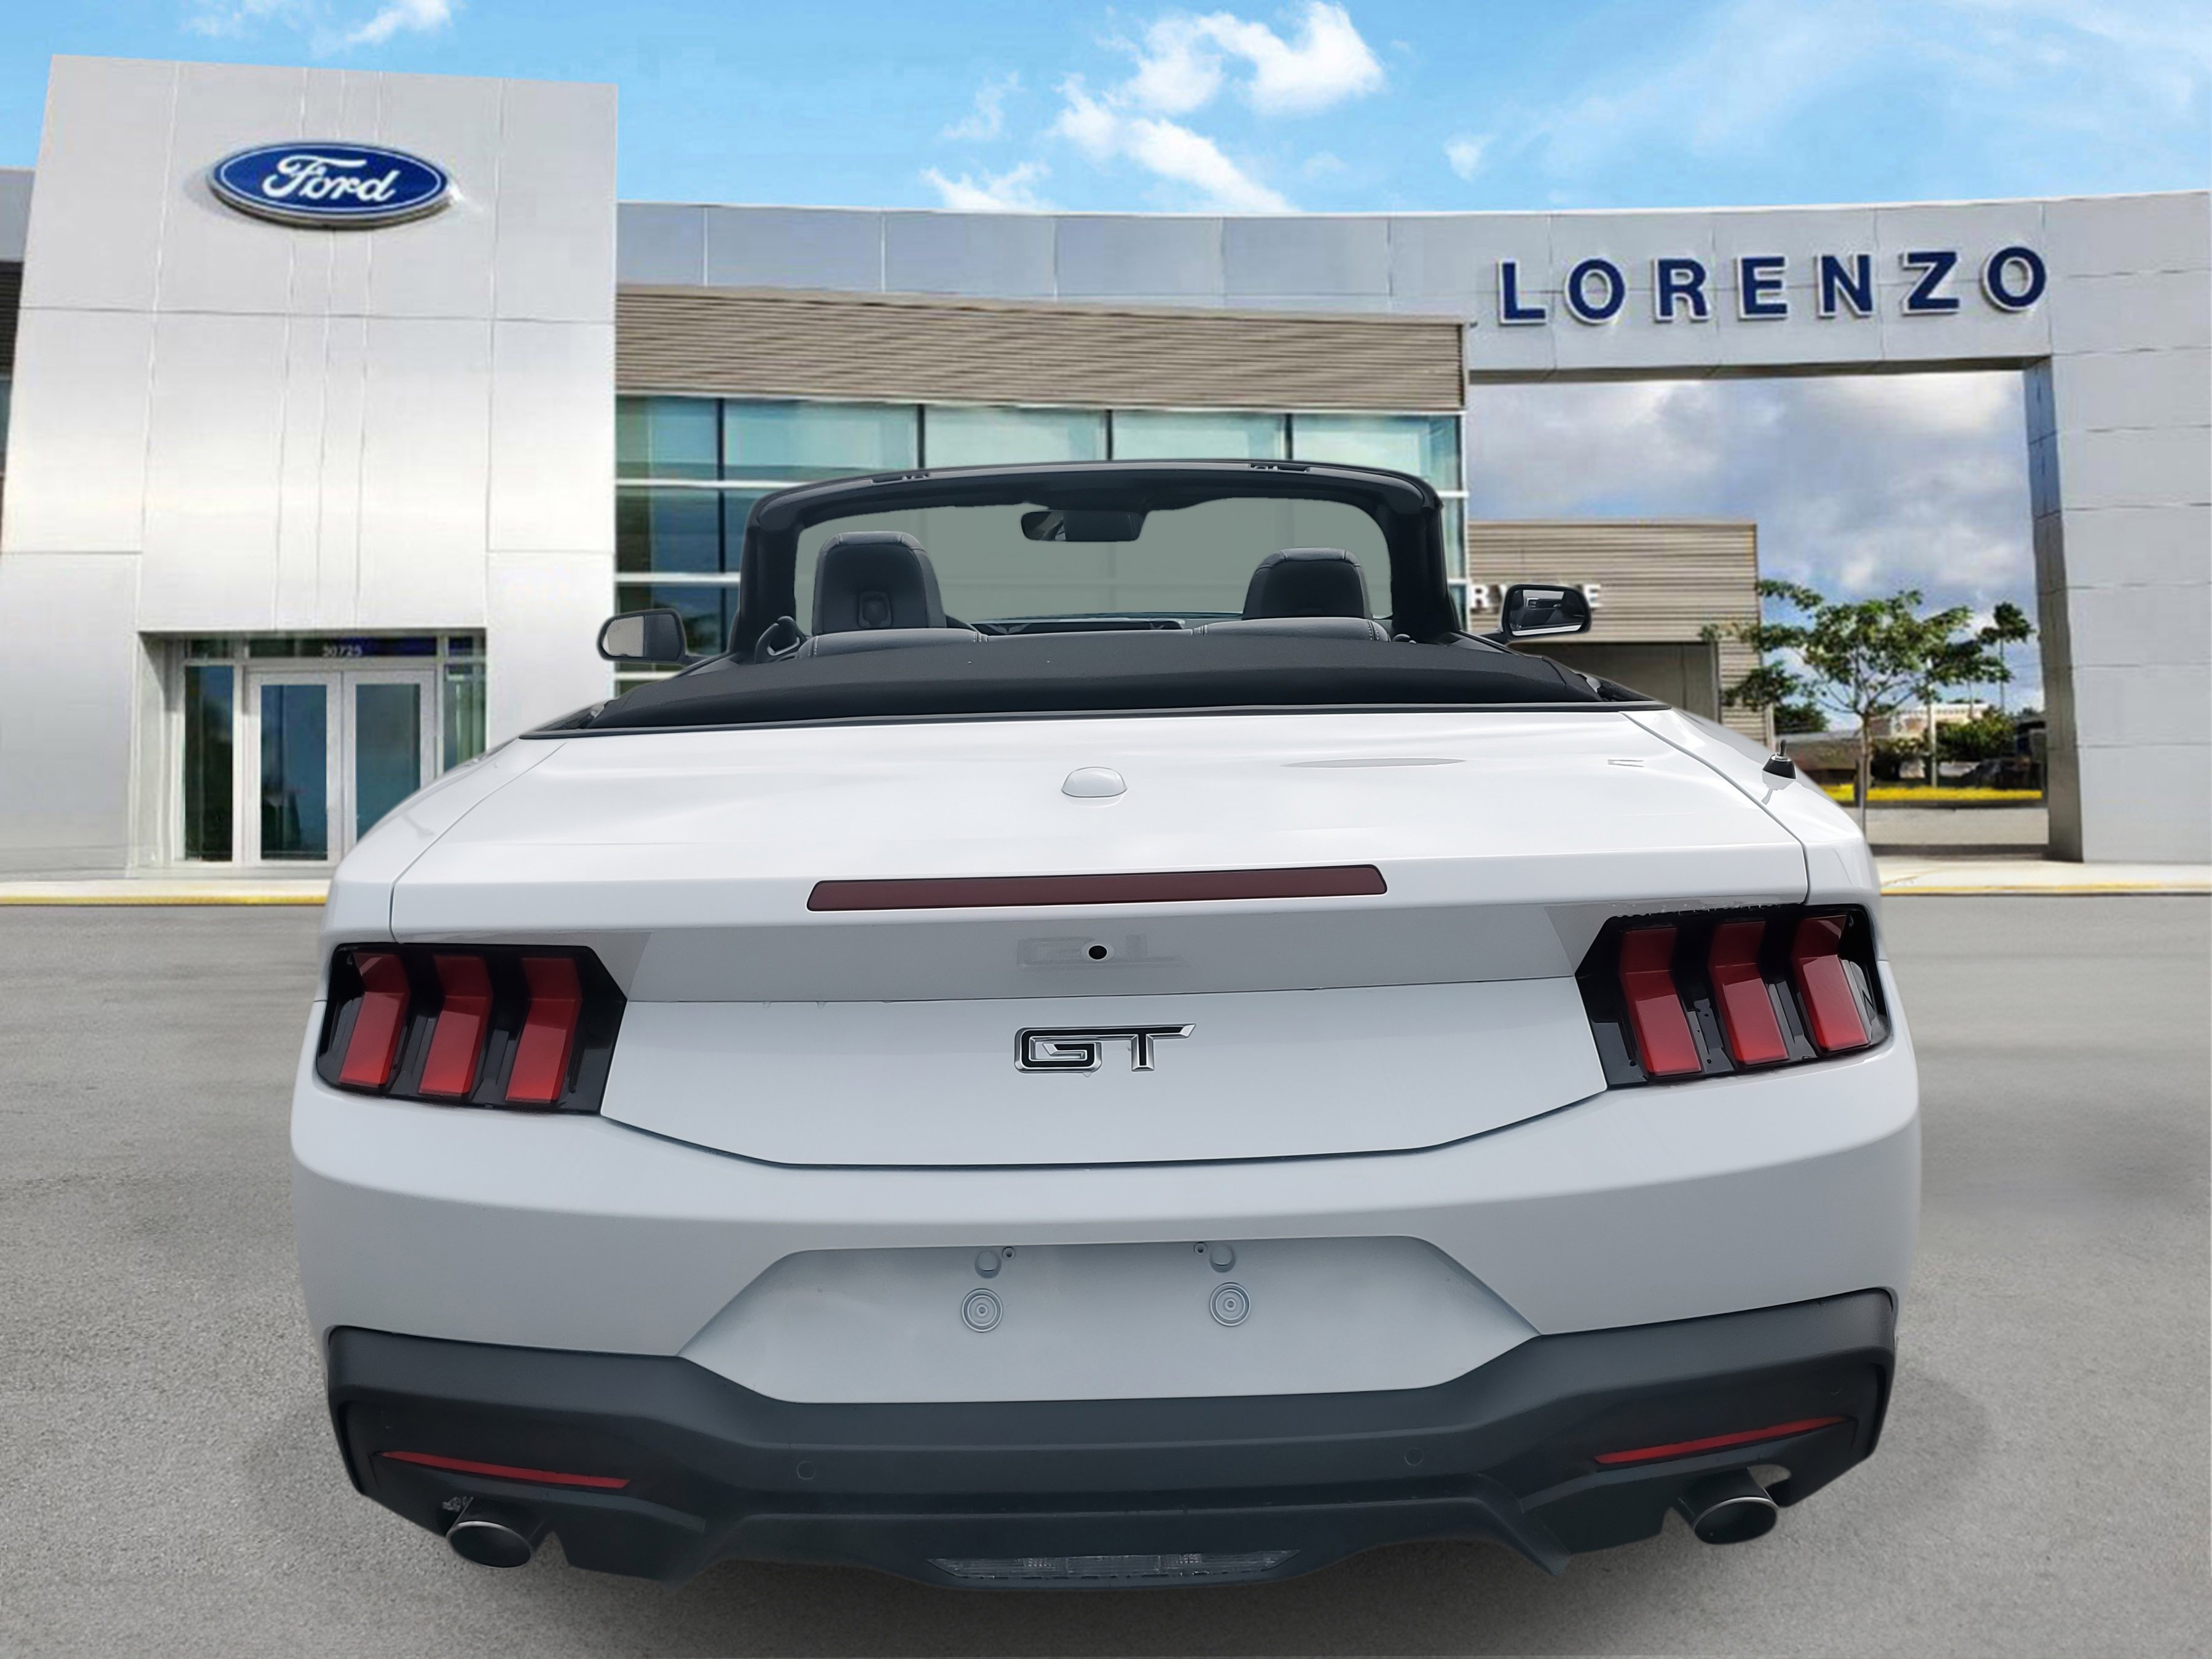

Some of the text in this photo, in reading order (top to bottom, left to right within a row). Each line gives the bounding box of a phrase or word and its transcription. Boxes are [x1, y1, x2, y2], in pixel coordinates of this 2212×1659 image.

[262, 154, 400, 202] Ford
[1498, 246, 2047, 324] LORENZO
[1014, 1023, 1196, 1074] GT
